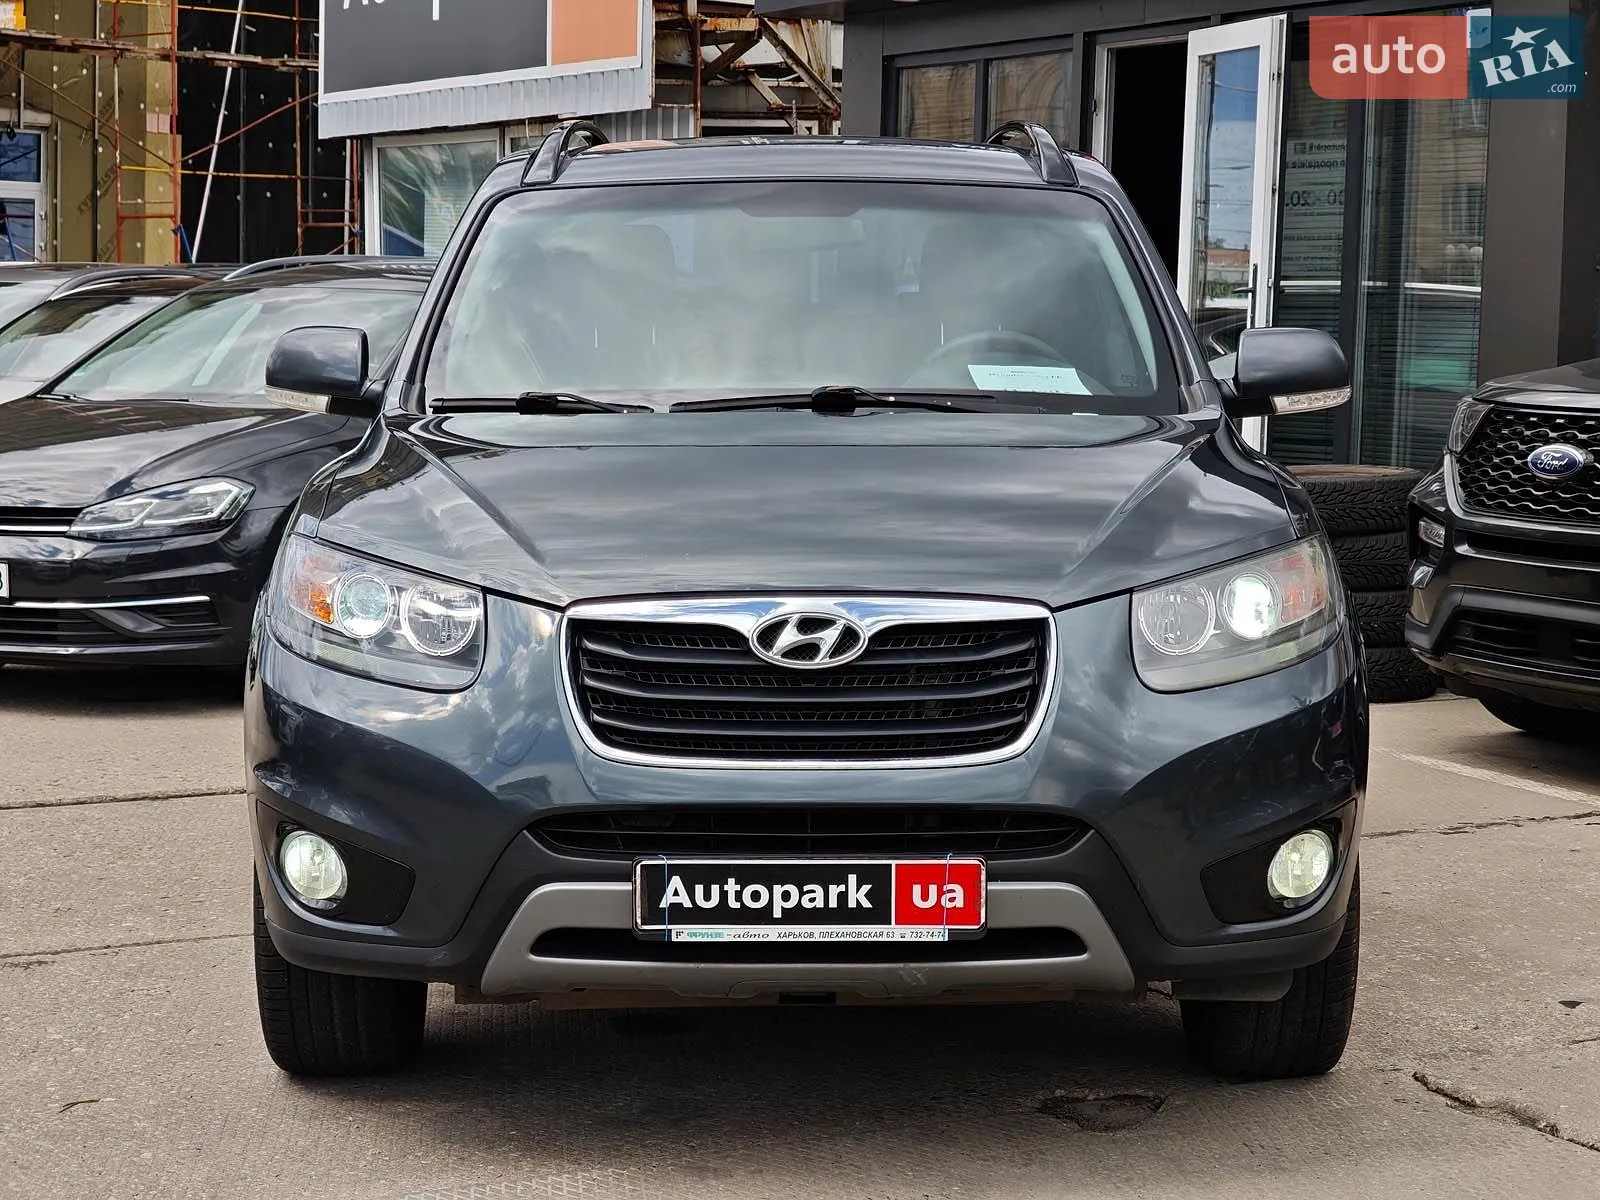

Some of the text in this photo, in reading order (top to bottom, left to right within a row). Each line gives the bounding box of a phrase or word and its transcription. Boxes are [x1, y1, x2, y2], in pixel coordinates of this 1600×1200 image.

[1537, 451, 1569, 470] Ford
[659, 874, 873, 918] Autopark
[911, 882, 964, 909] ua
[776, 931, 816, 940] ХАРЬКОВ,
[818, 931, 884, 939] ПЛЕХАНОВСКАЯ
